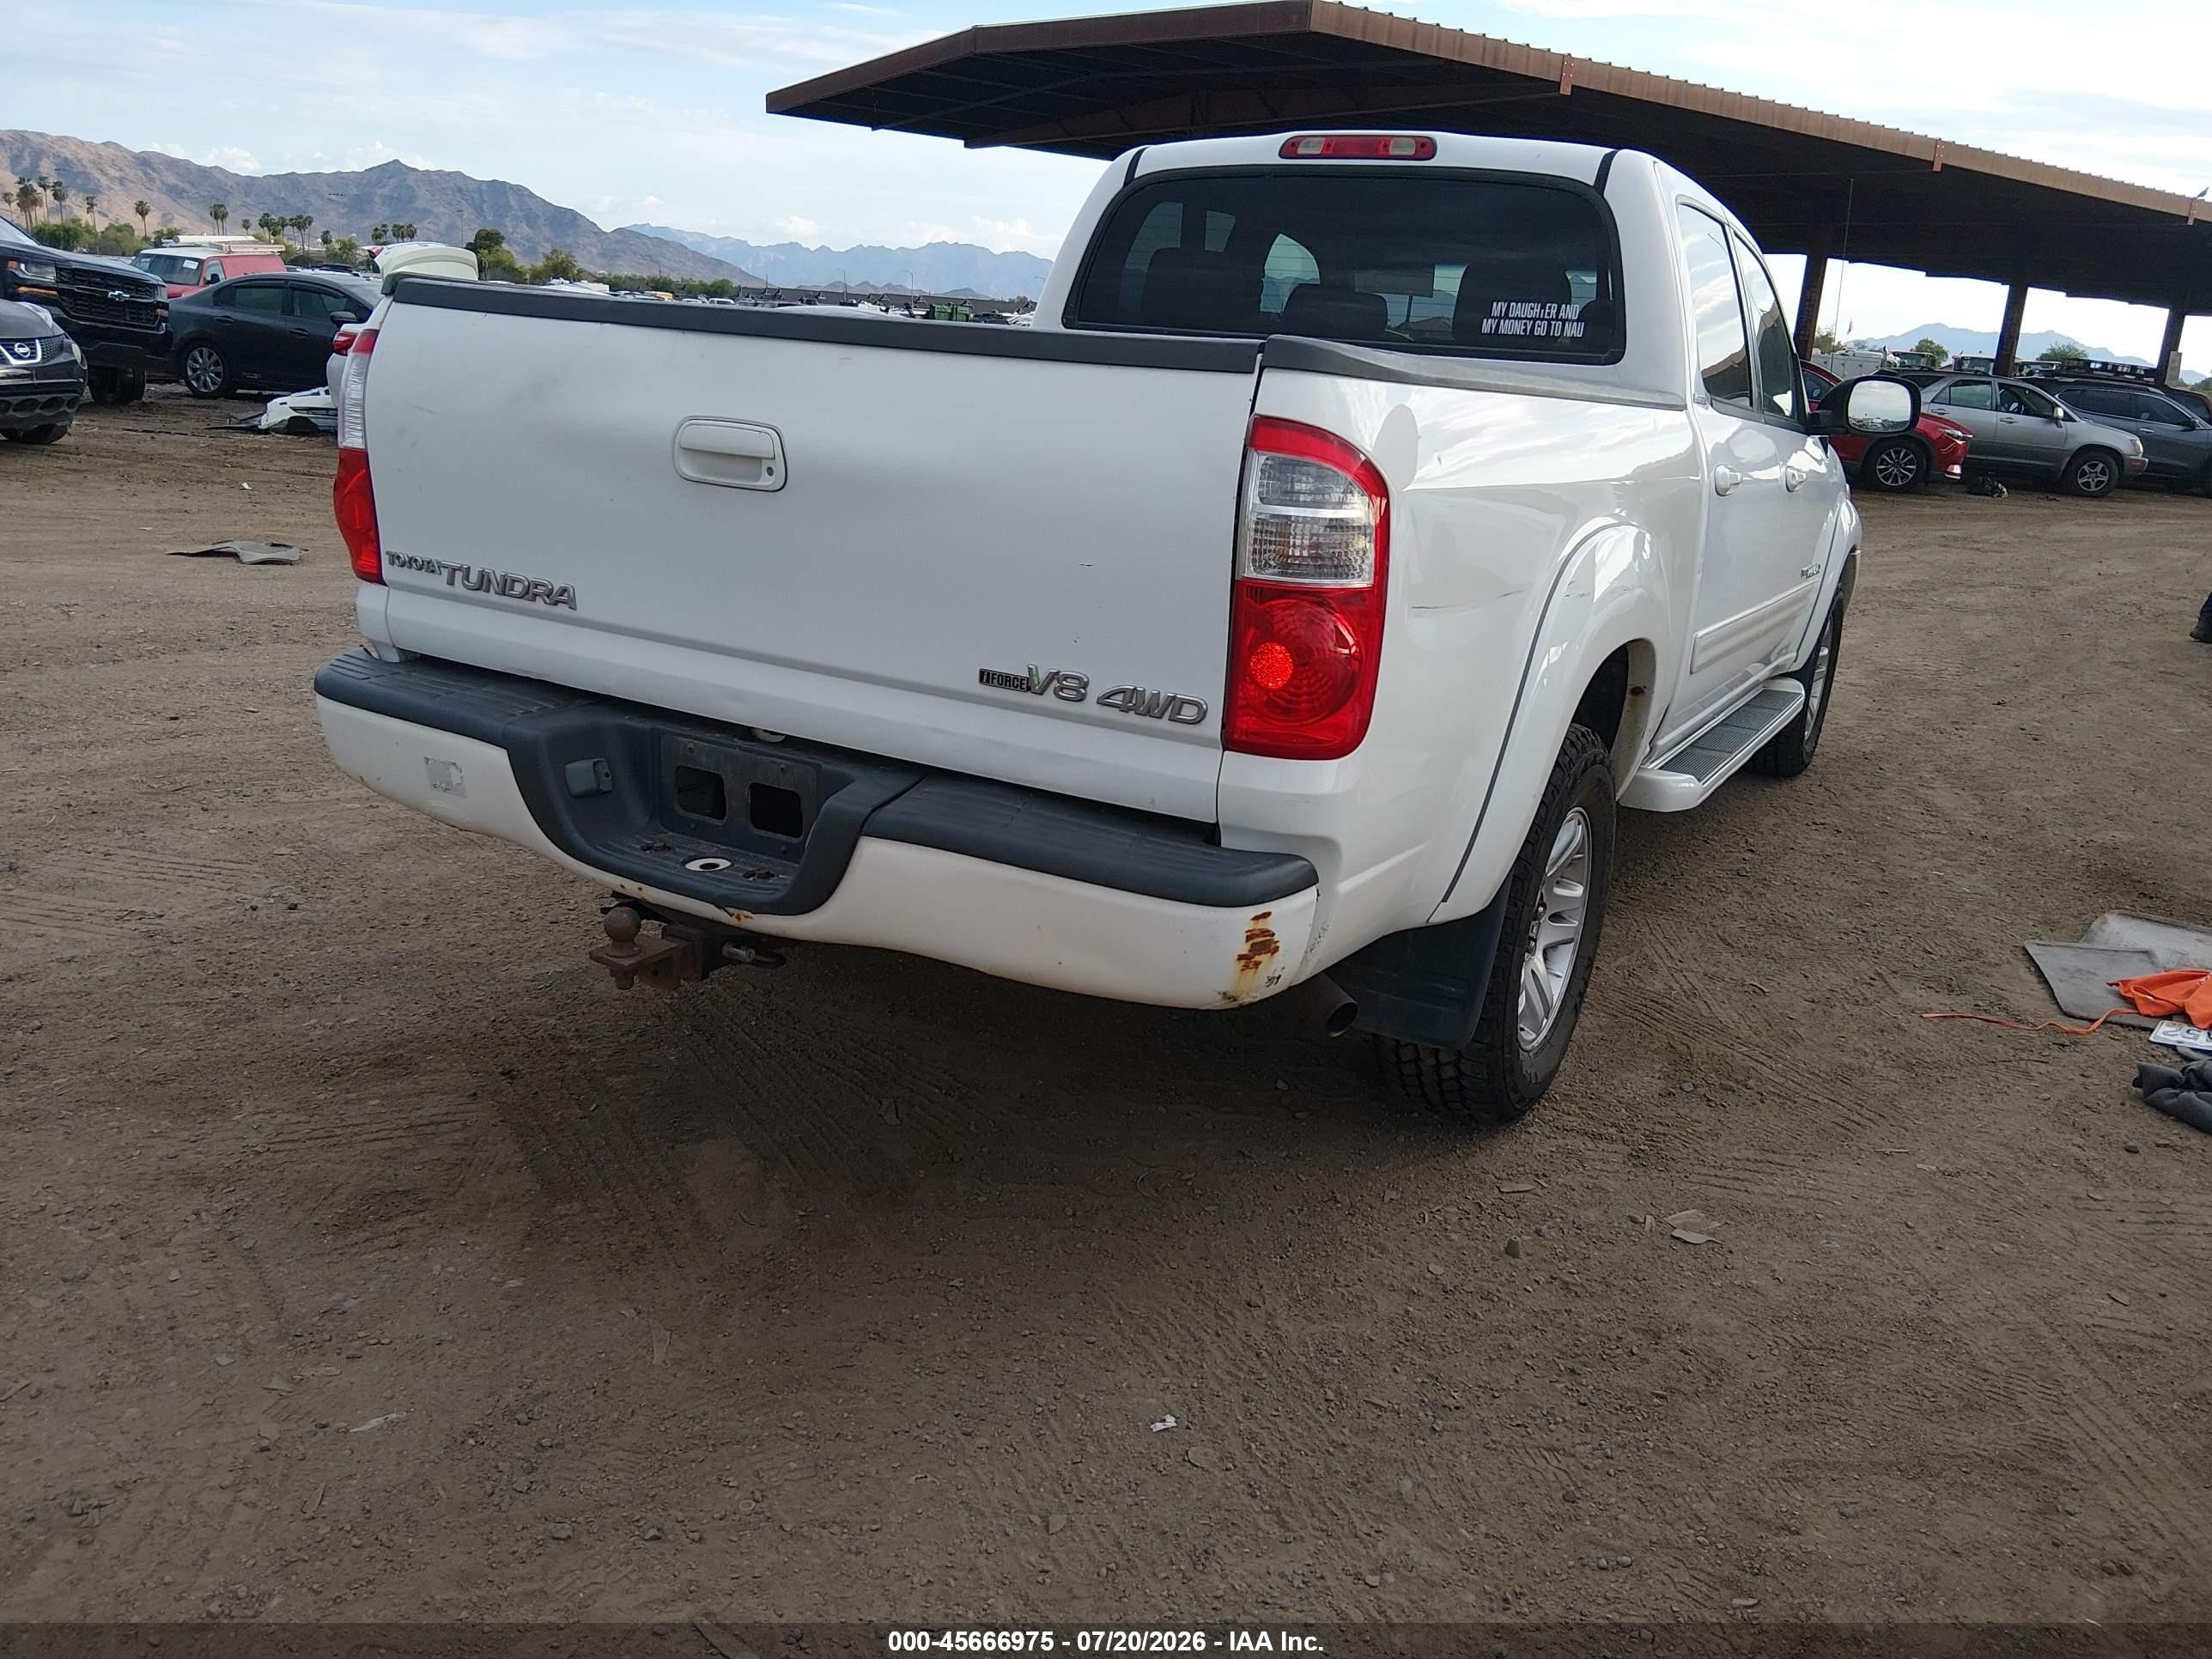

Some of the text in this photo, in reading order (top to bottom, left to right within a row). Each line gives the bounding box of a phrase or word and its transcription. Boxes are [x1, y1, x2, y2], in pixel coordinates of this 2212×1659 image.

[1481, 319, 1585, 337] MY MONEY GO TO NAU
[1492, 302, 1508, 318] MY
[1558, 303, 1580, 319] AND
[386, 550, 577, 611] TOYOTA TUNDRA
[1027, 664, 1090, 702] V8
[1097, 684, 1208, 725] 4WD
